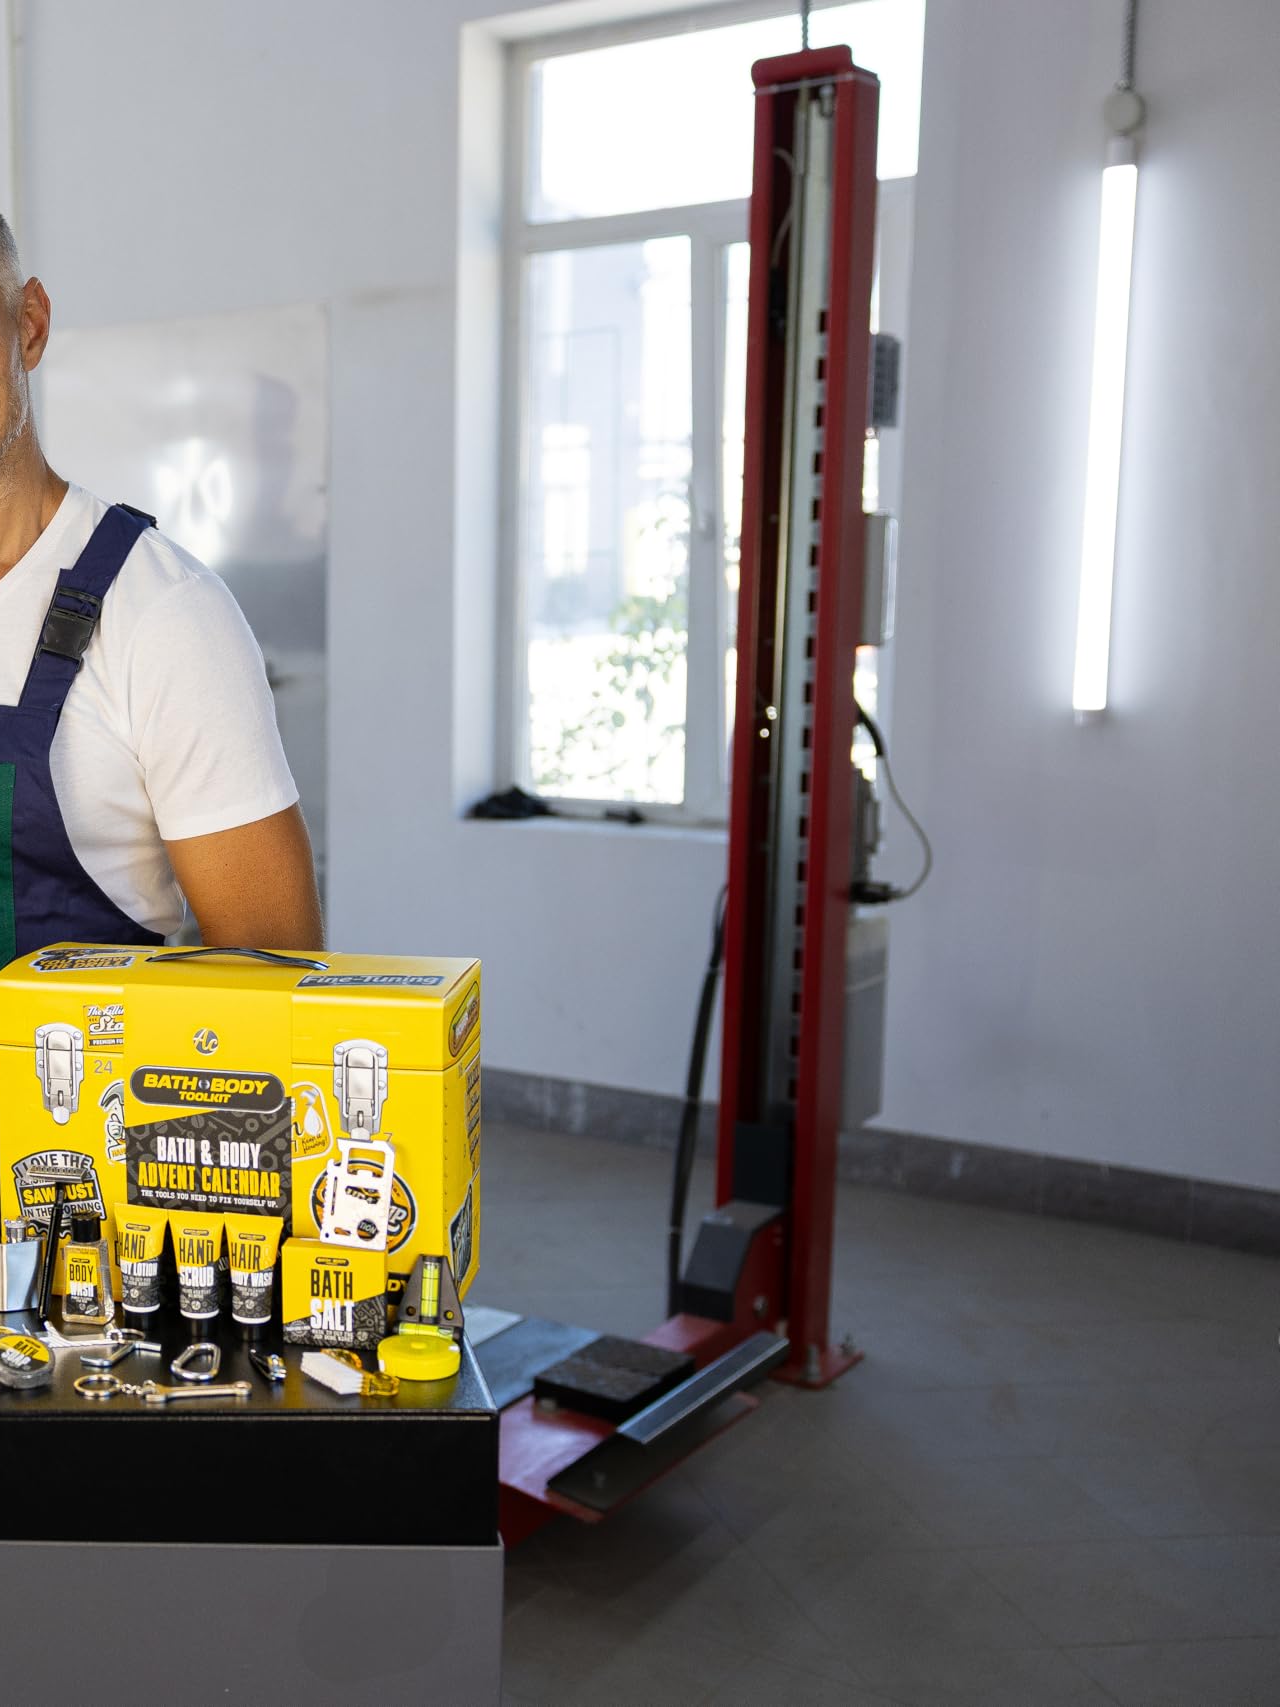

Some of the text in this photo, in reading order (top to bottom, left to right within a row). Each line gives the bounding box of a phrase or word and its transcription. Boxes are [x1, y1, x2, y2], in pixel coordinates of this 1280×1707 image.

[302, 975, 438, 986] Fine-Tuning
[87, 1004, 124, 1017] The Filli
[93, 1059, 113, 1074] 24
[143, 1073, 270, 1095] BATH BODY
[179, 1090, 232, 1104] TOOLKIT
[62, 1152, 90, 1169] THE
[156, 1136, 195, 1164] BATH
[200, 1139, 214, 1166] &
[219, 1141, 261, 1169] BODY
[138, 1161, 281, 1198] ADVENT CALENDAR
[22, 1182, 95, 1206] SAWUST
[141, 1189, 280, 1209] THE TOOLS YOU NEED TO FIX YOURSELF UP.
[23, 1201, 102, 1219] IN THE ORNING
[118, 1231, 146, 1261] HAND
[178, 1236, 215, 1265] HAND
[230, 1241, 262, 1271] HAIR
[69, 1263, 94, 1283] BODY
[133, 1262, 158, 1277] LOTION
[179, 1265, 215, 1288] SCRUB
[250, 1271, 274, 1288] WASH
[310, 1268, 353, 1300] BATH
[309, 1297, 355, 1333] SALT
[0, 1348, 32, 1367] SOAP
[13, 1339, 40, 1358] BATH
